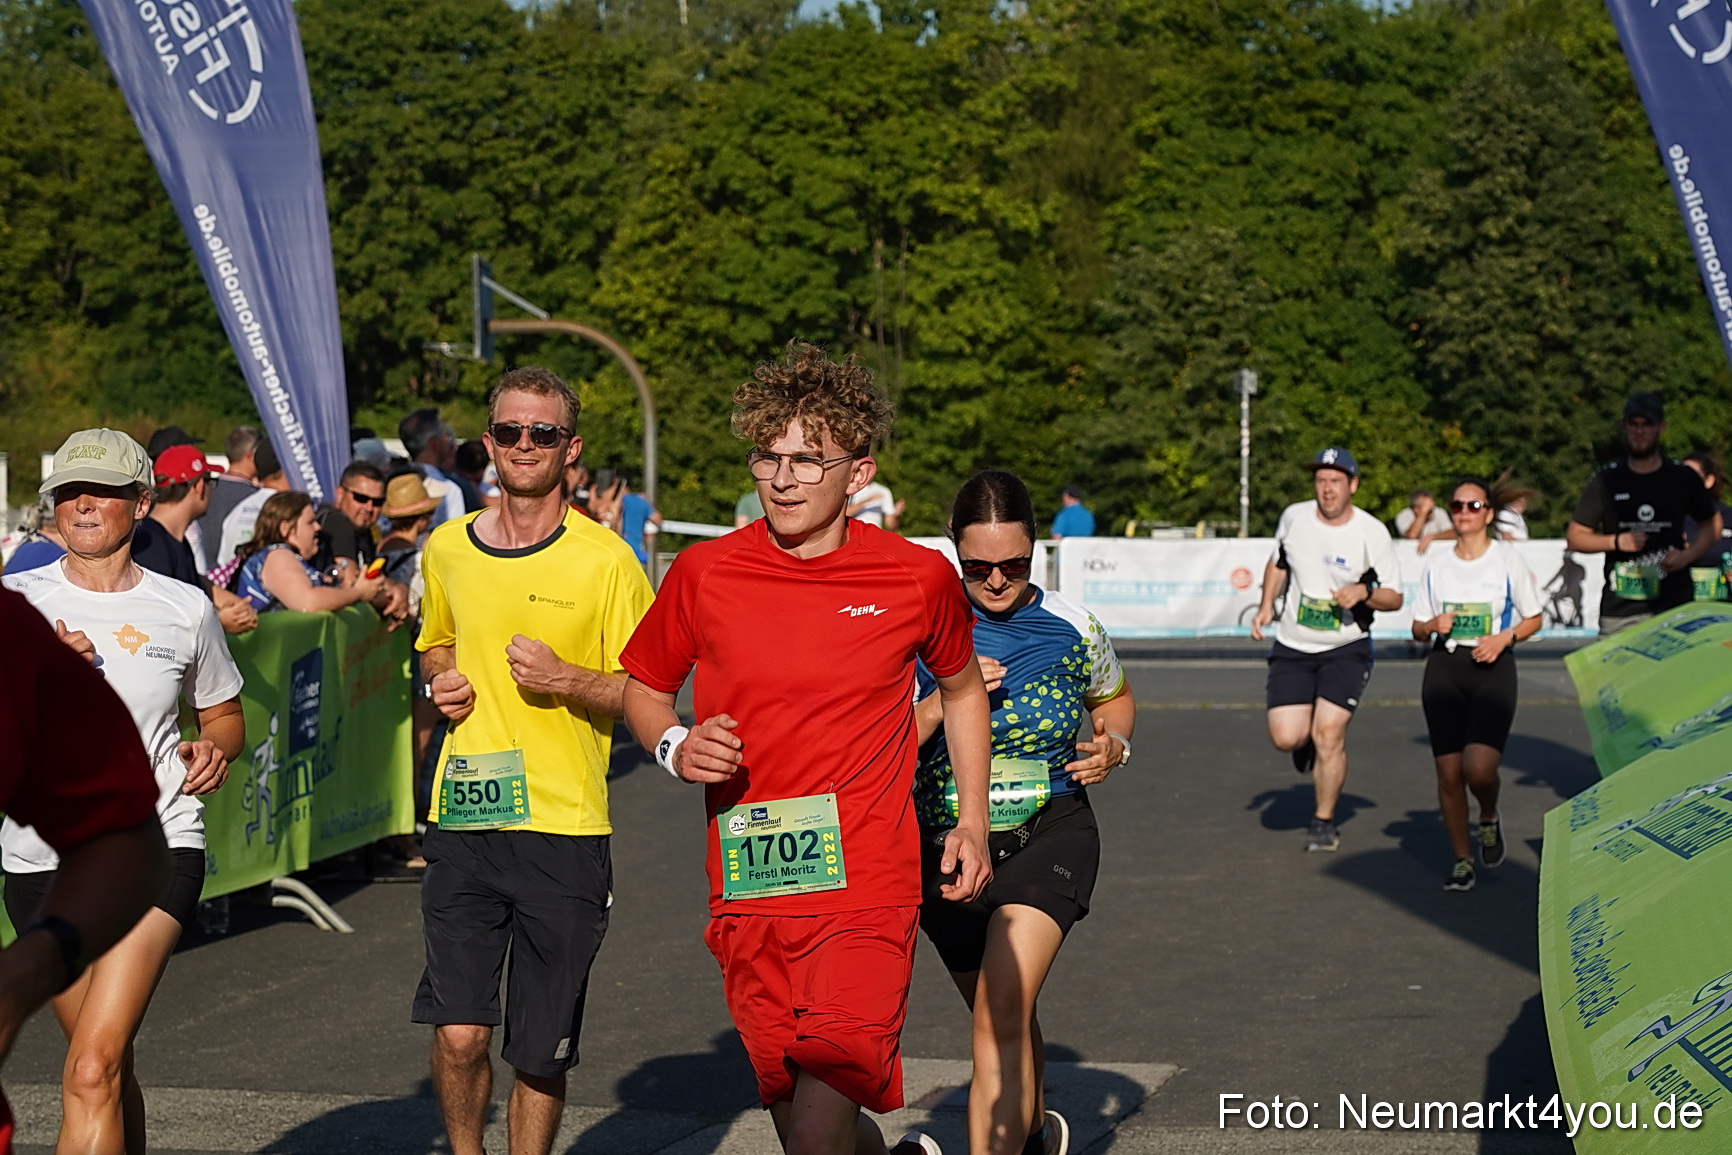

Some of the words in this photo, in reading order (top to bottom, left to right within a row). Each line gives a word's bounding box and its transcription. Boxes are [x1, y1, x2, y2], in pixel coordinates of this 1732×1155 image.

[850, 604, 876, 617] DEHN
[145, 645, 176, 656] LANDKREIS
[145, 652, 175, 661] NEUMARKT
[453, 779, 501, 806] 550
[512, 779, 525, 815] 2022
[446, 808, 477, 818] Pflieger
[479, 805, 514, 816] Markus
[997, 807, 1029, 817] Kristin
[747, 816, 782, 829] Firmenlauf
[740, 829, 821, 867] 1702
[823, 831, 839, 876] 2022
[728, 849, 740, 881] RUN
[748, 869, 778, 880] Ferstl
[781, 864, 816, 877] Moritz
[1053, 864, 1073, 880] GORE
